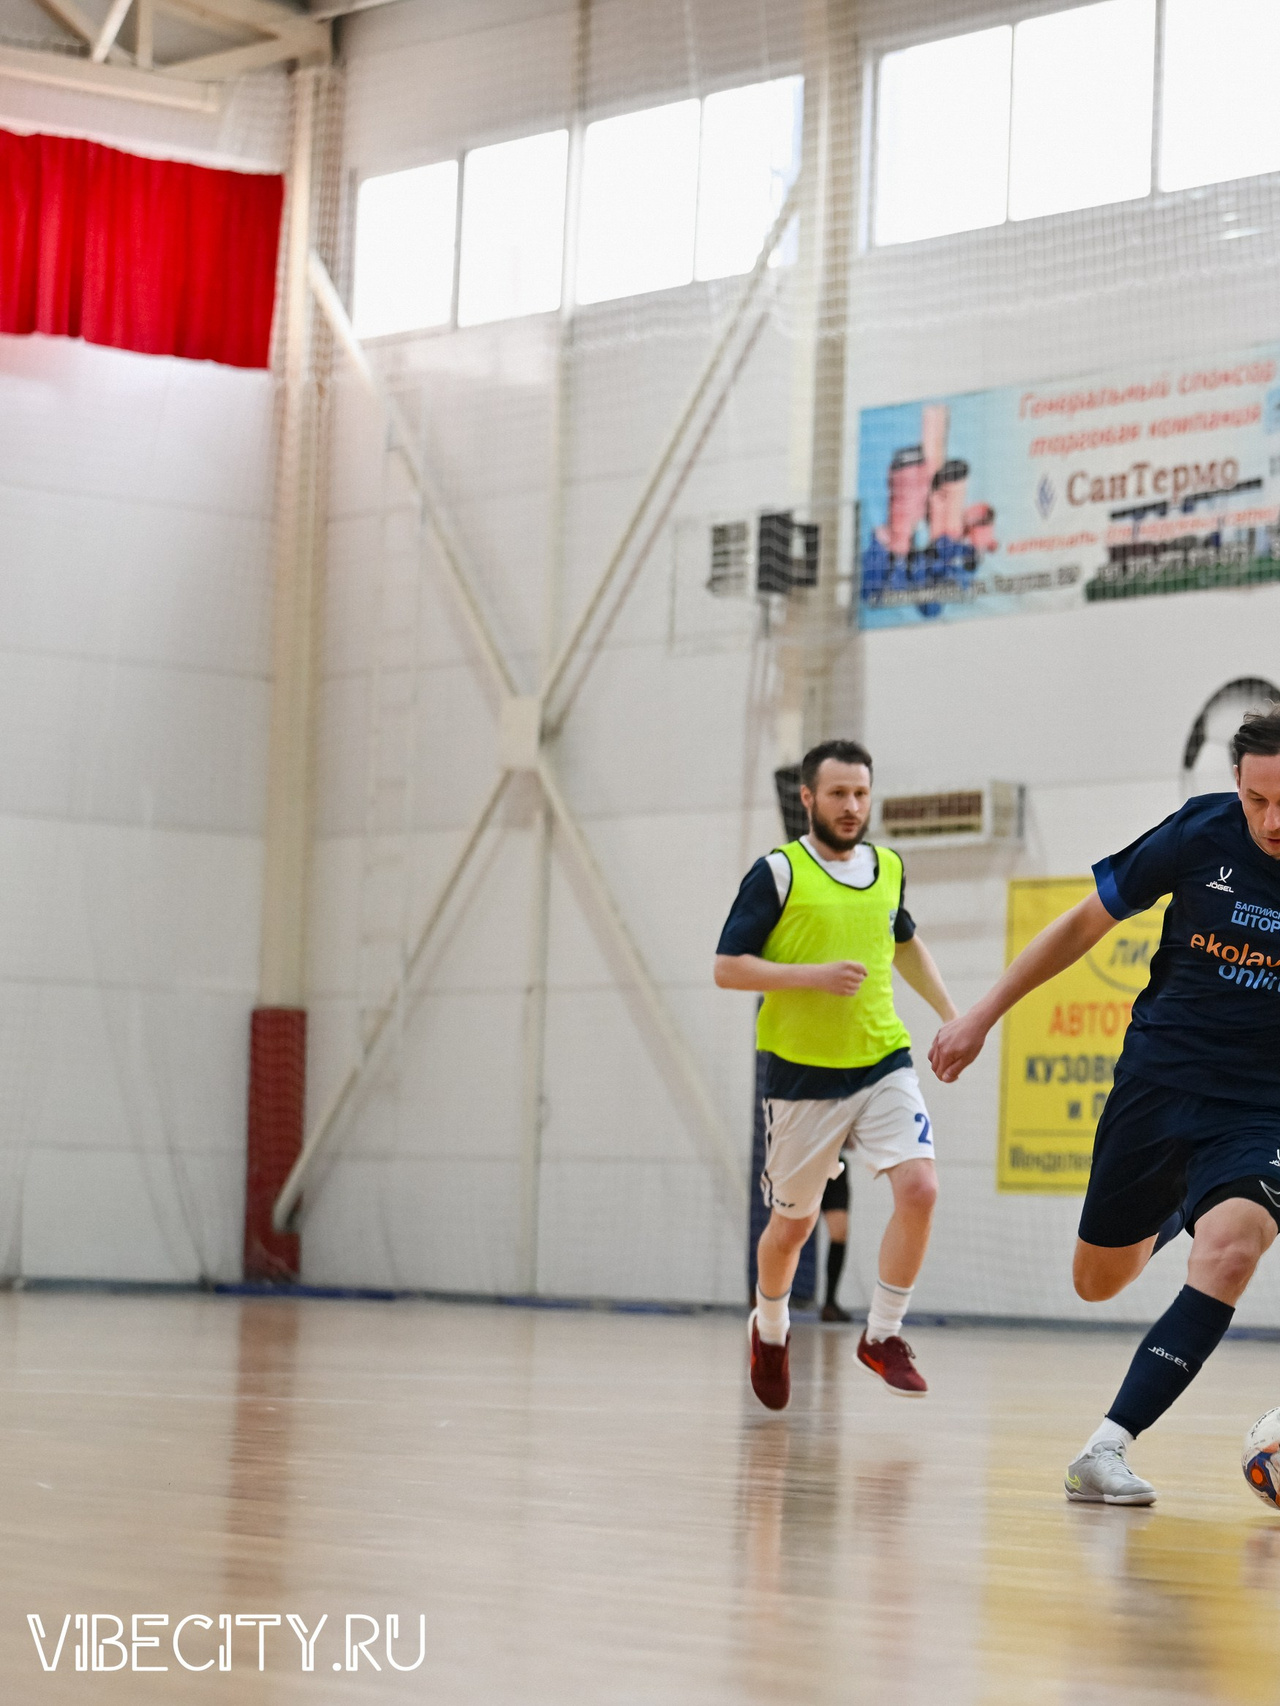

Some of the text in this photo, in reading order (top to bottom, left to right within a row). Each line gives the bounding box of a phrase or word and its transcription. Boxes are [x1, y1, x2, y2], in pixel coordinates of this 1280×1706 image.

[1066, 456, 1239, 507] СанТермо
[1205, 881, 1235, 894] JÖGEL
[1147, 1346, 1190, 1373] JÖGEL
